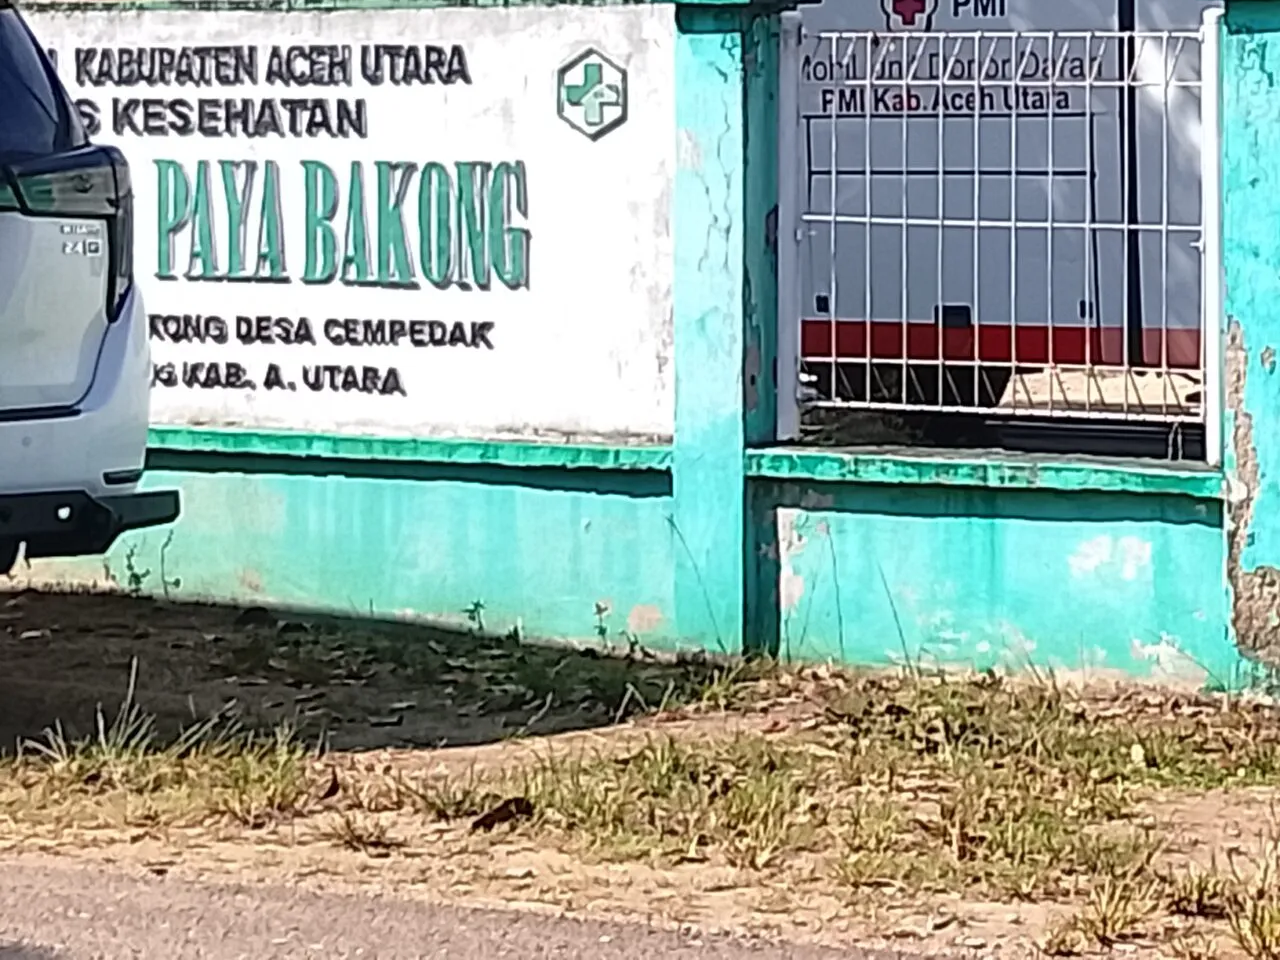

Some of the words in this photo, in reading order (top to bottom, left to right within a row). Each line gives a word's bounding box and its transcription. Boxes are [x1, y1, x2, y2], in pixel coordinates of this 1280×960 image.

[75, 45, 258, 87] KABUPATEN
[265, 45, 350, 86] ACEH
[360, 46, 471, 84] UTARA
[112, 97, 367, 138] KESEHATAN
[822, 88, 866, 113] PMI
[932, 86, 994, 111] Aceh
[153, 159, 290, 283] PAYA
[299, 160, 532, 291] BAKONG
[236, 315, 315, 345] DESA
[324, 318, 495, 349] CEMPEDAK
[303, 365, 408, 397] UTARA
